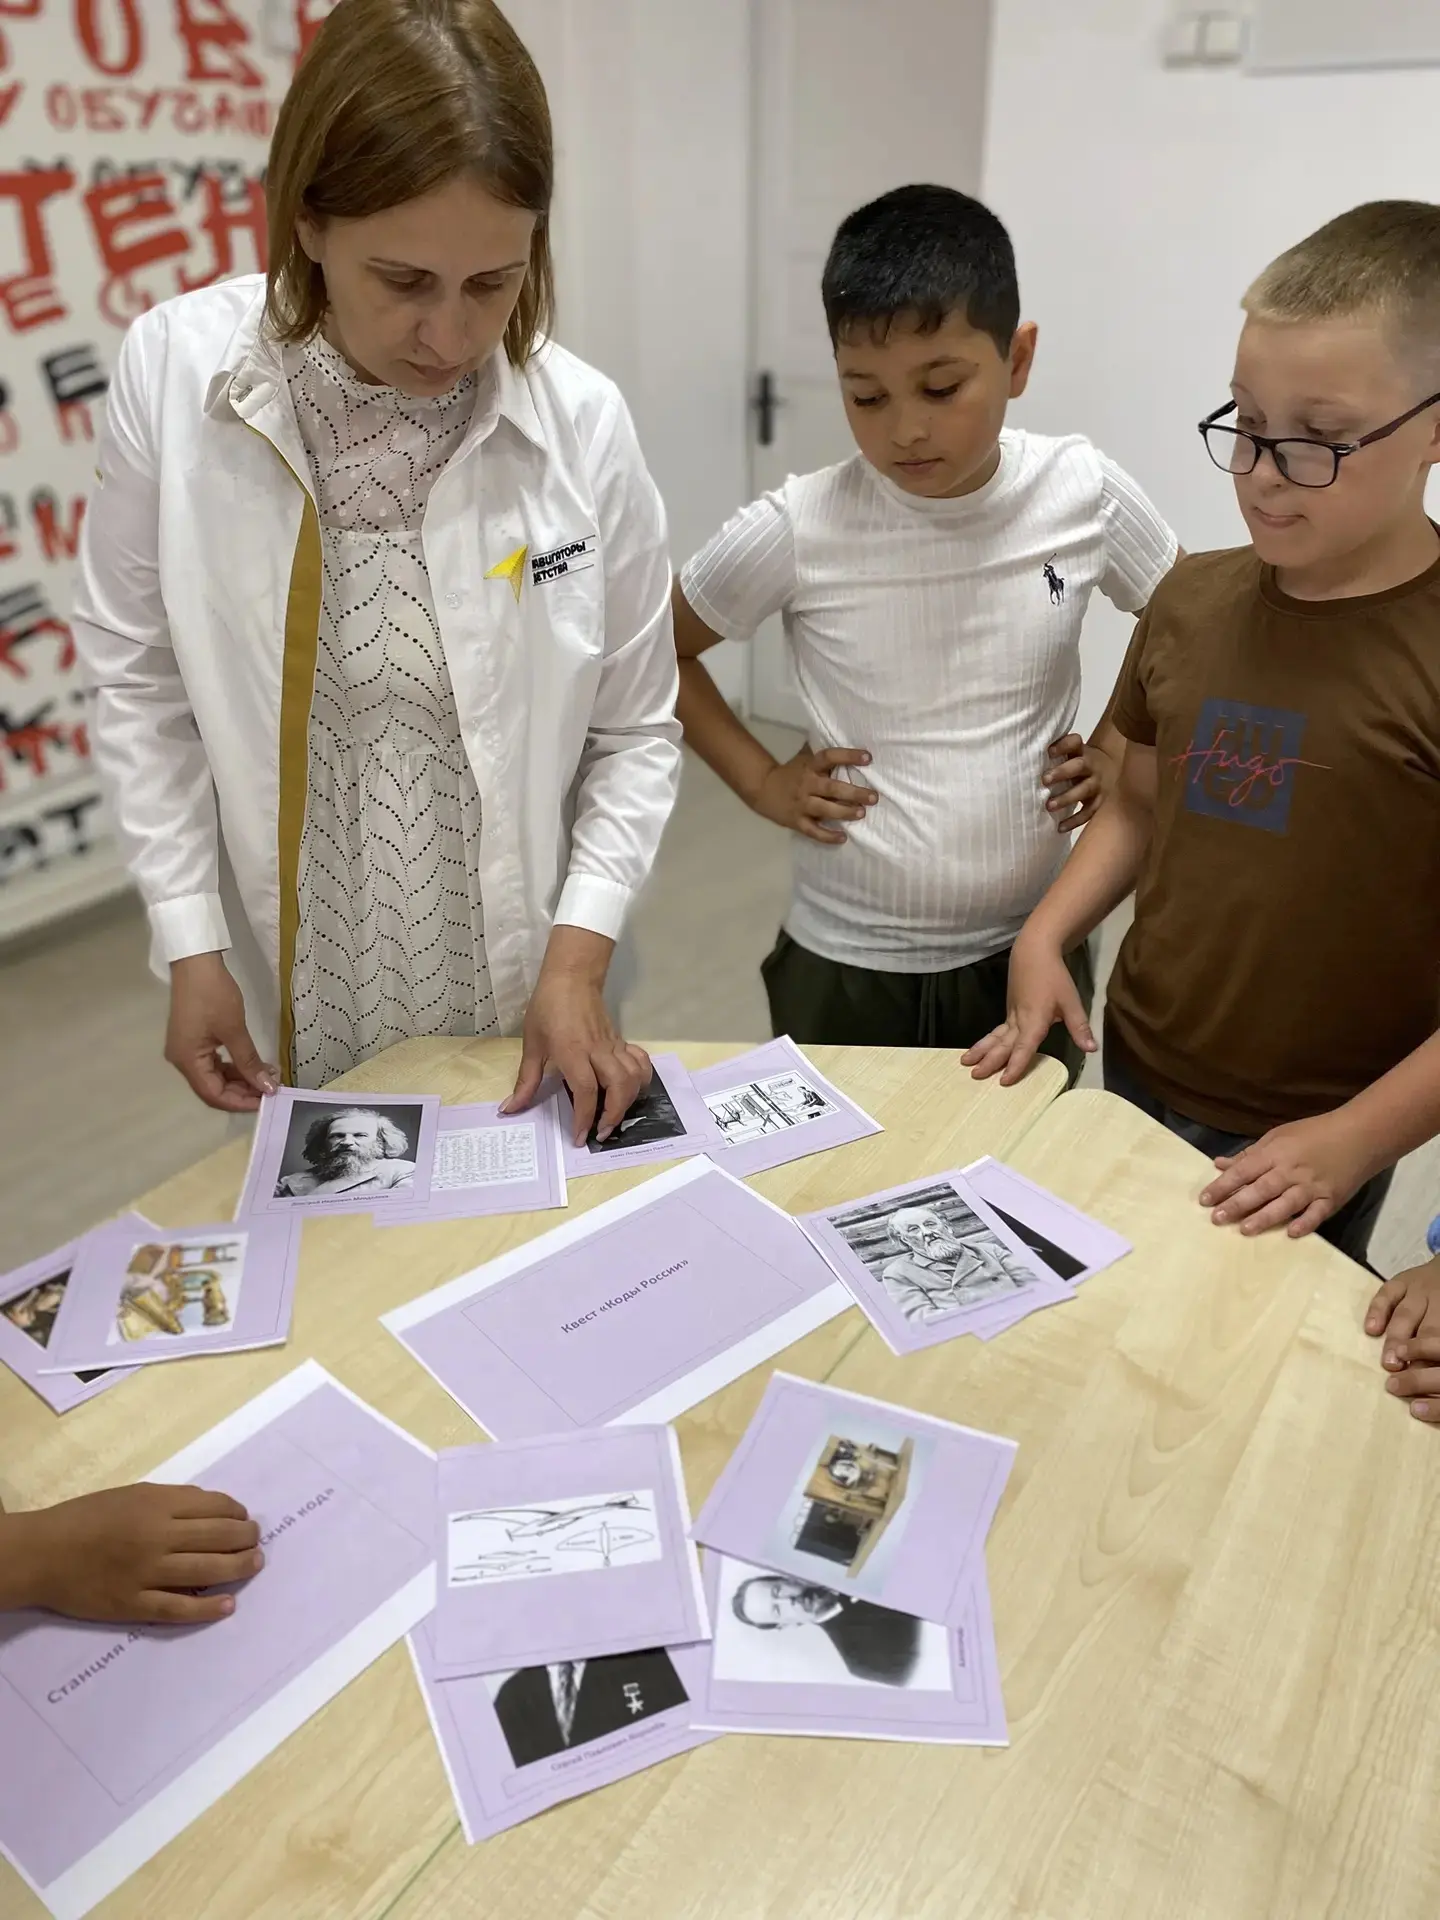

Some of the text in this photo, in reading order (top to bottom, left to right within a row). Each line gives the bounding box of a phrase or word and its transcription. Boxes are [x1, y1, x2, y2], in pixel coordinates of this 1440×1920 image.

[1167, 729, 1334, 807] Hugo
[560, 1259, 689, 1334] Квест «Коды России»
[46, 1643, 126, 1704] Станция
